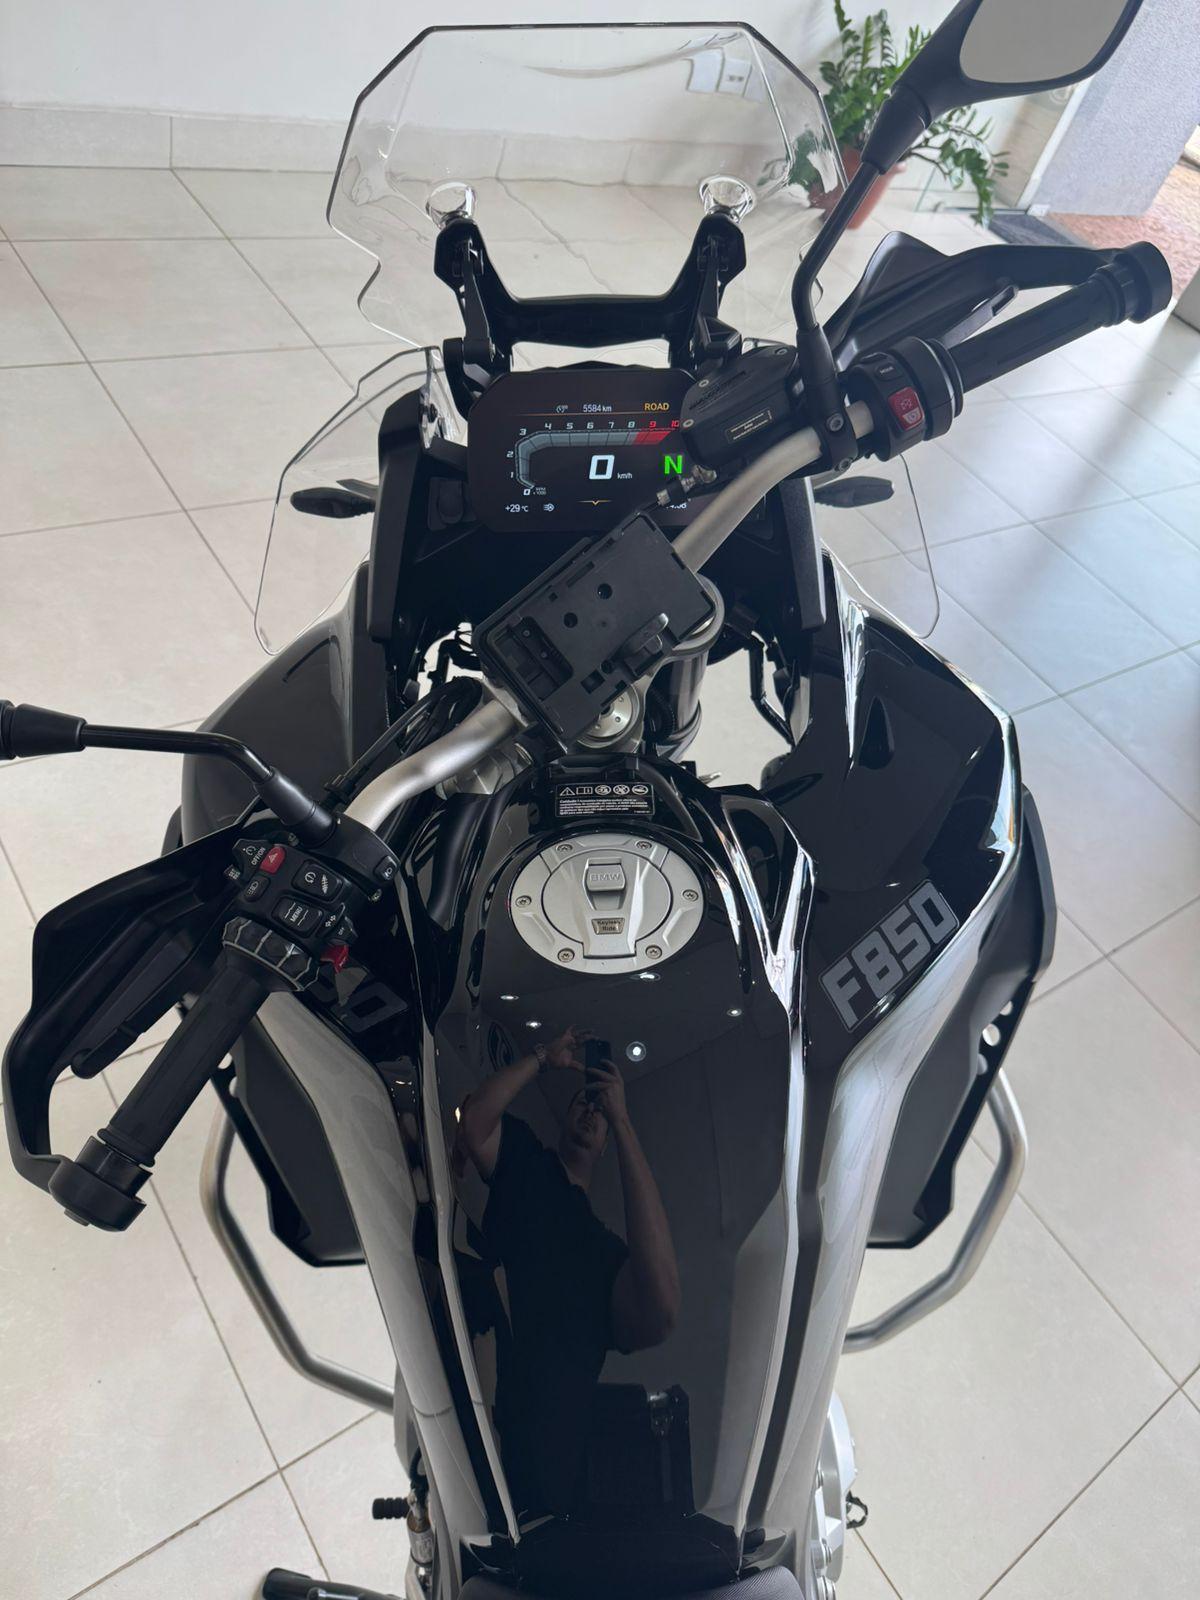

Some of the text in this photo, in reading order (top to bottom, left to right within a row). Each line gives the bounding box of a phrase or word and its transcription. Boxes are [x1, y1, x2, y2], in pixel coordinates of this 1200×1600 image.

[582, 404, 612, 413] 5584 km
[644, 402, 670, 411] ROAD
[544, 422, 552, 430] 4
[608, 421, 615, 429] 7
[649, 420, 657, 428] 9
[671, 420, 680, 428] 10
[519, 428, 527, 436] 3
[588, 454, 633, 480] 0 km/h
[664, 455, 683, 474] N
[589, 873, 621, 881] BMW
[290, 906, 303, 922] MENU
[821, 882, 957, 1029] F850
